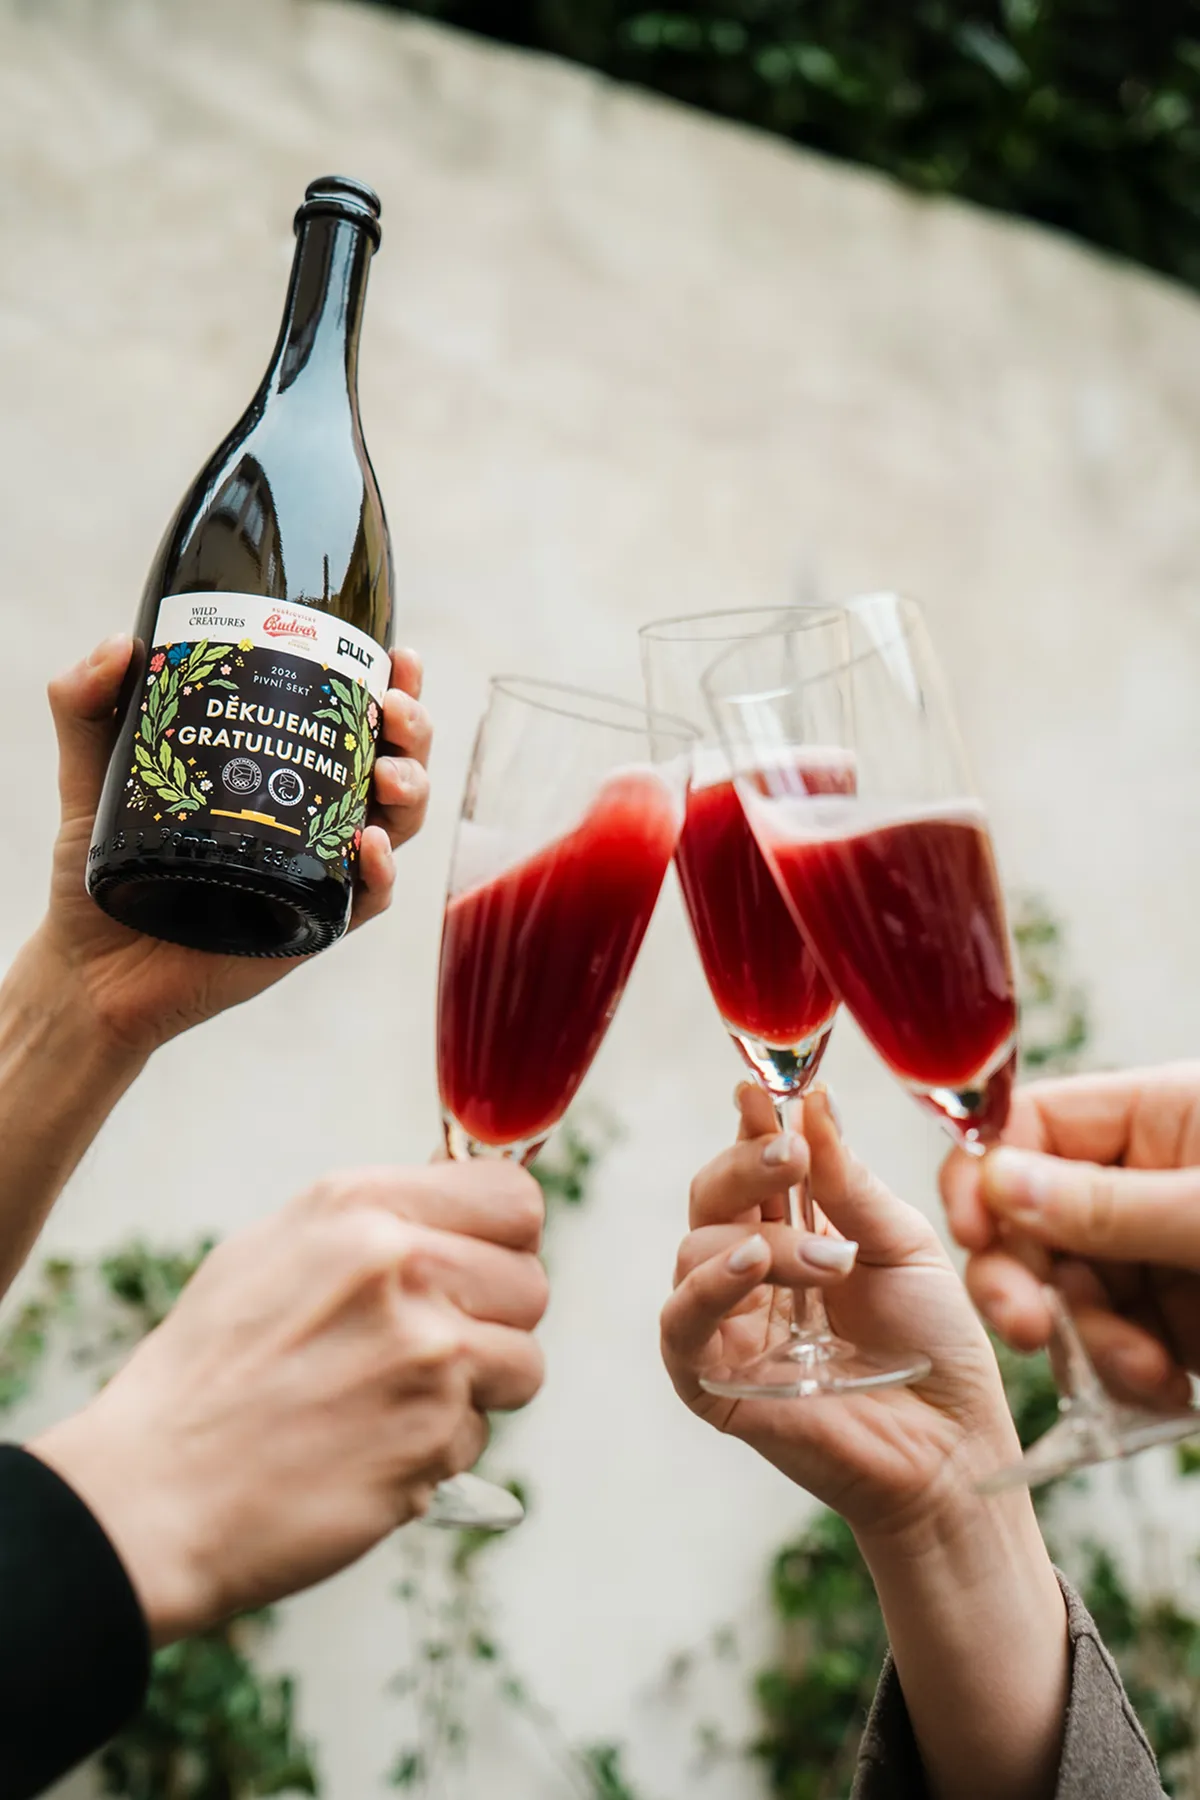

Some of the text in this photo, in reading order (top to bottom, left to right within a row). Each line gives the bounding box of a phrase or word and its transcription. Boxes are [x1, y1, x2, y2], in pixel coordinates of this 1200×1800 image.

[188, 616, 246, 628] CREATURES
[191, 606, 218, 616] WILD
[263, 614, 318, 640] Budvar
[271, 666, 297, 680] 2026
[253, 675, 310, 697] PIVNÍ SEKT
[206, 694, 338, 749] DĚKUJEME!
[178, 726, 349, 787] GRATULUJEME!
